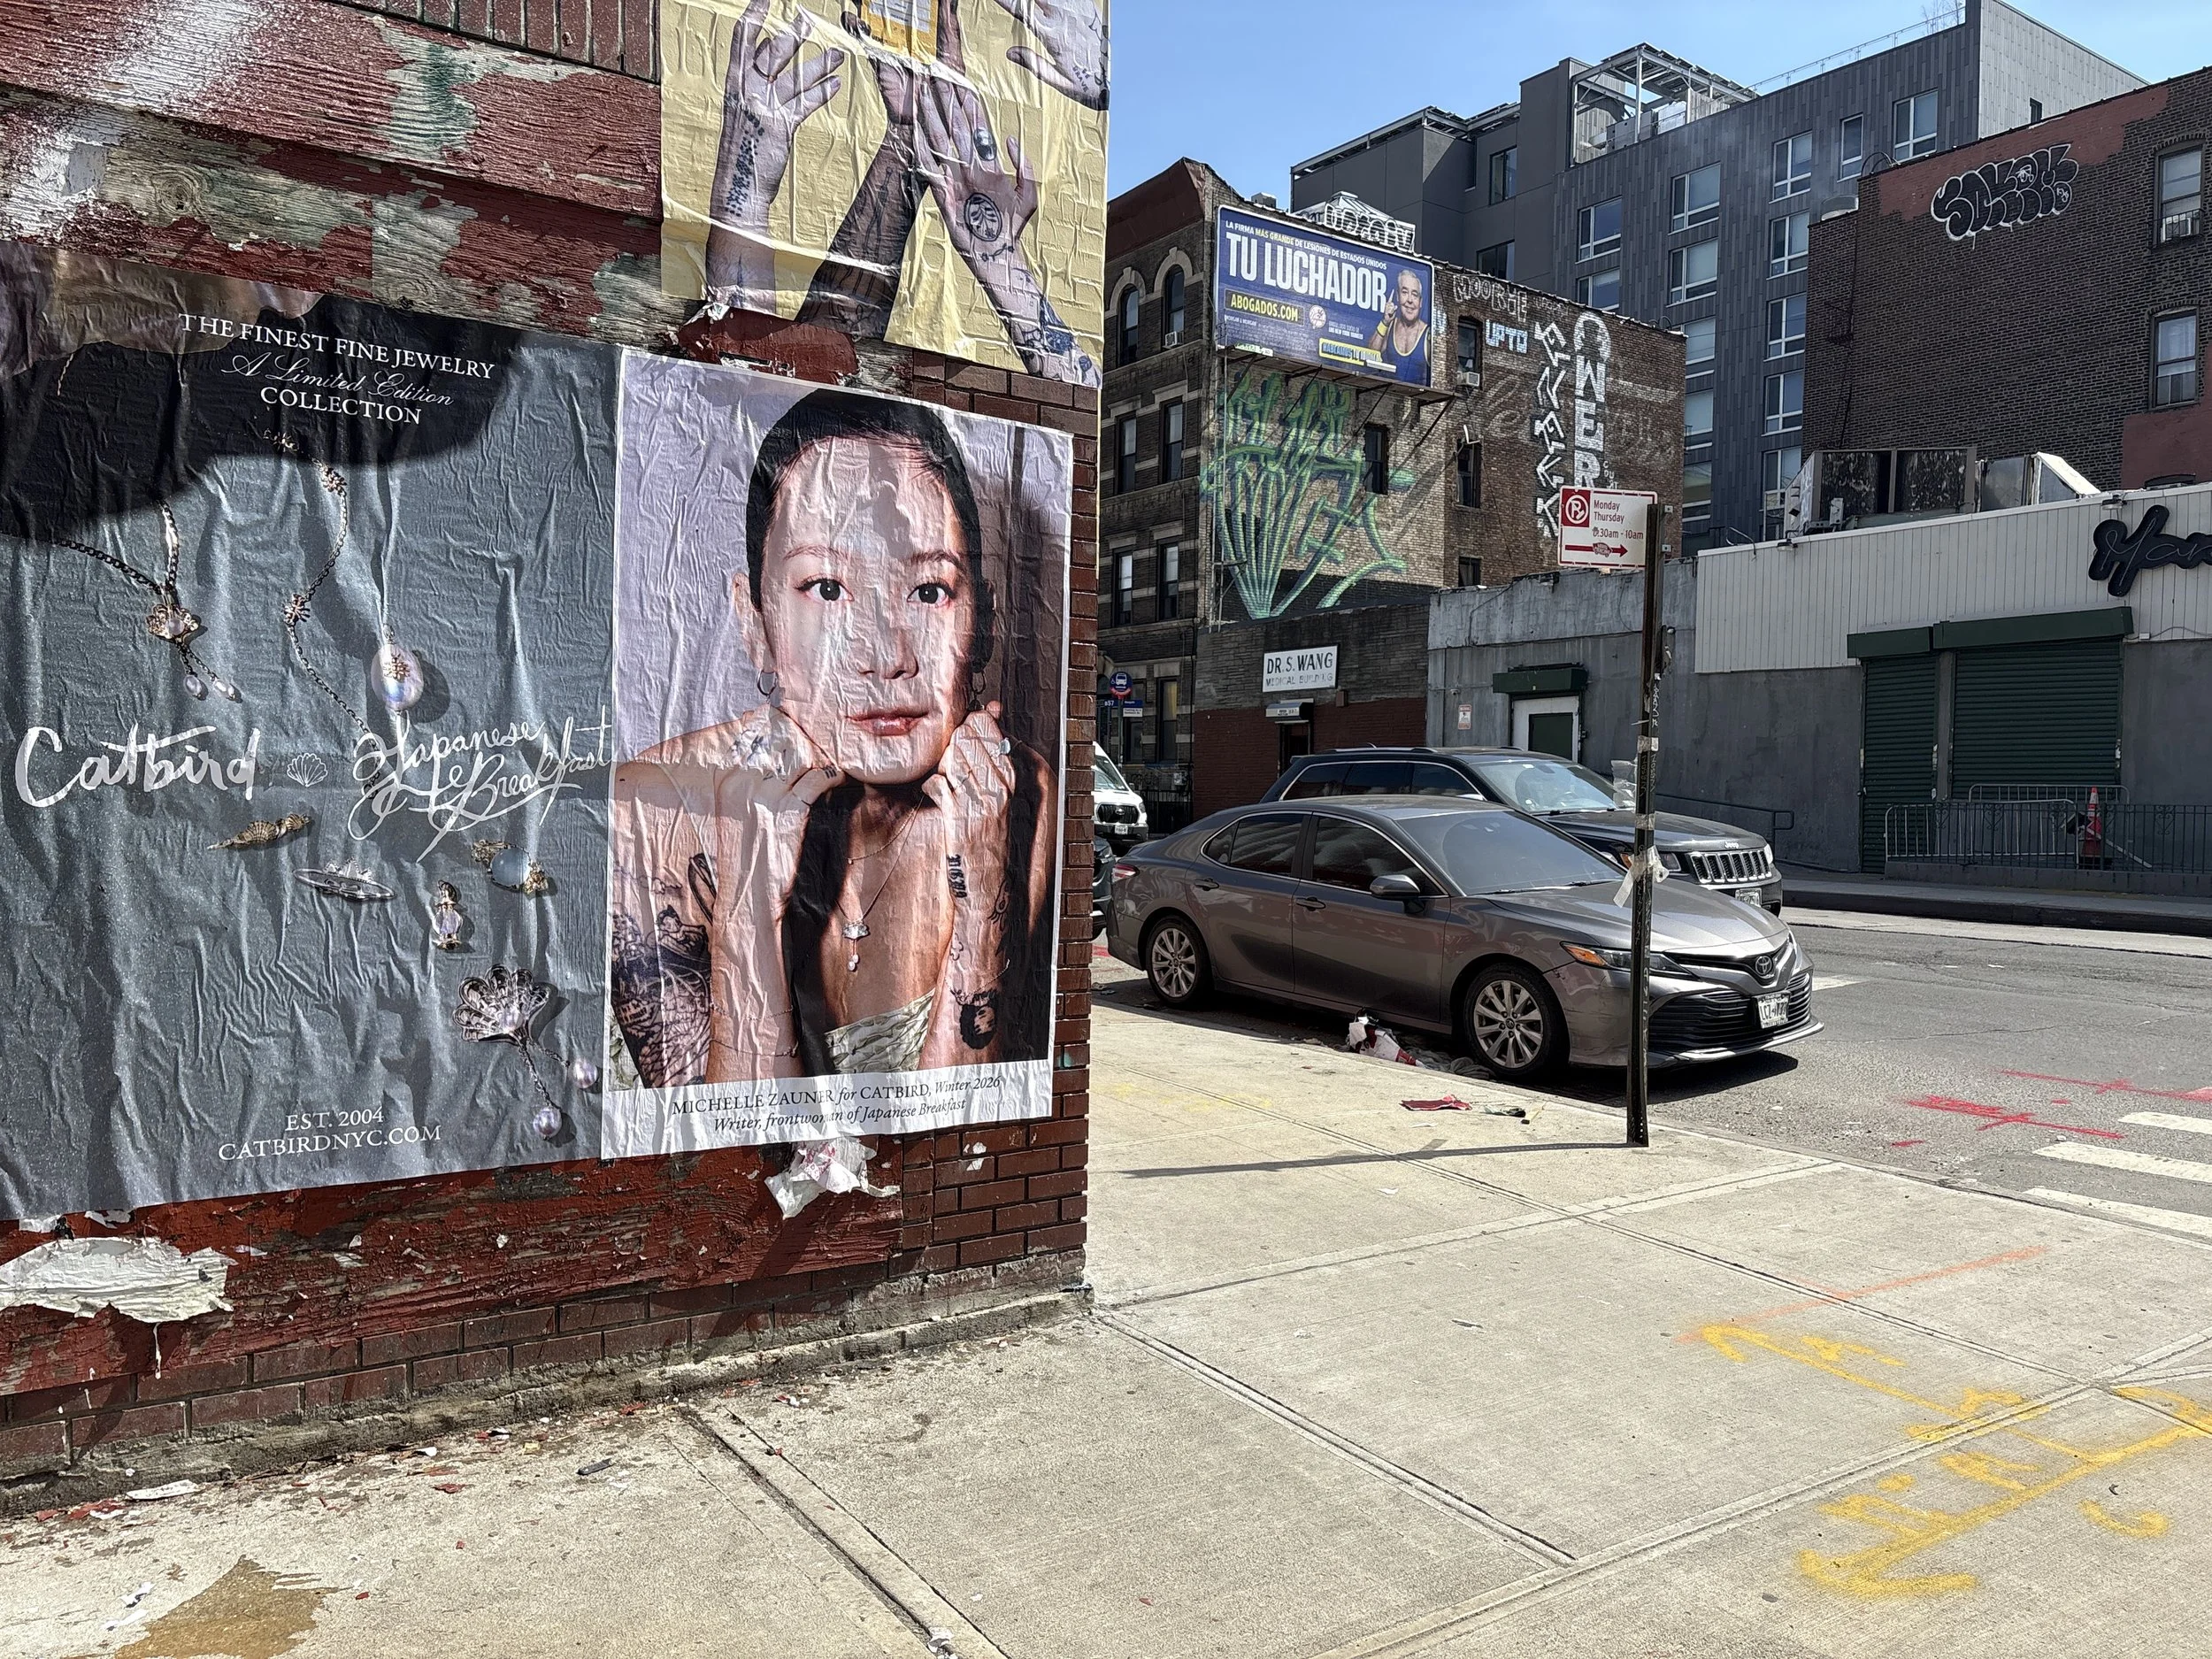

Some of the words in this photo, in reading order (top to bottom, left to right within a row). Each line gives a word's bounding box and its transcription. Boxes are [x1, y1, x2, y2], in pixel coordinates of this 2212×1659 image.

[1225, 220, 1233, 229] LA
[1235, 223, 1254, 235] FIRMA
[1270, 231, 1294, 245] GRANDE
[1294, 239, 1303, 248] DE
[1304, 241, 1331, 254] LESIONES
[1332, 248, 1340, 257] DE
[1340, 251, 1365, 265] ESTADOS
[1366, 257, 1387, 270] UNIDOS
[1225, 231, 1257, 281] TU
[1264, 242, 1388, 313] LUCHADOR
[1231, 294, 1299, 322] ABOGADOS.COM
[178, 313, 234, 338] THE
[239, 323, 329, 354] FINEST
[334, 337, 389, 363] FINE
[390, 348, 495, 380] JEWELRY
[220, 352, 273, 378] A
[265, 354, 366, 392] Limited
[368, 370, 455, 406] Edition
[260, 387, 422, 425] COLLECTION
[1594, 500, 1620, 512] Monday
[1594, 511, 1625, 525] Thursday
[1625, 529, 1644, 540] 10am
[1267, 657, 1284, 674] DR.
[1286, 657, 1295, 672] S.
[1297, 652, 1333, 672] WANG
[15, 720, 261, 807] Catbird
[672, 1094, 764, 1115] MICHELLE
[768, 1090, 834, 1106] ZAUNER
[836, 1087, 856, 1104] for
[860, 1084, 932, 1100] CATBIRD,
[934, 1080, 972, 1093] Winter
[973, 1076, 1002, 1090] 2026
[285, 1113, 333, 1132] EST.
[338, 1106, 384, 1126] 2004
[714, 1118, 762, 1132] Writer,
[847, 1106, 863, 1124] of
[860, 1106, 916, 1123] Japanese
[918, 1098, 967, 1116] Breakfast
[218, 1125, 442, 1161] CATBIRDNYC.COM
